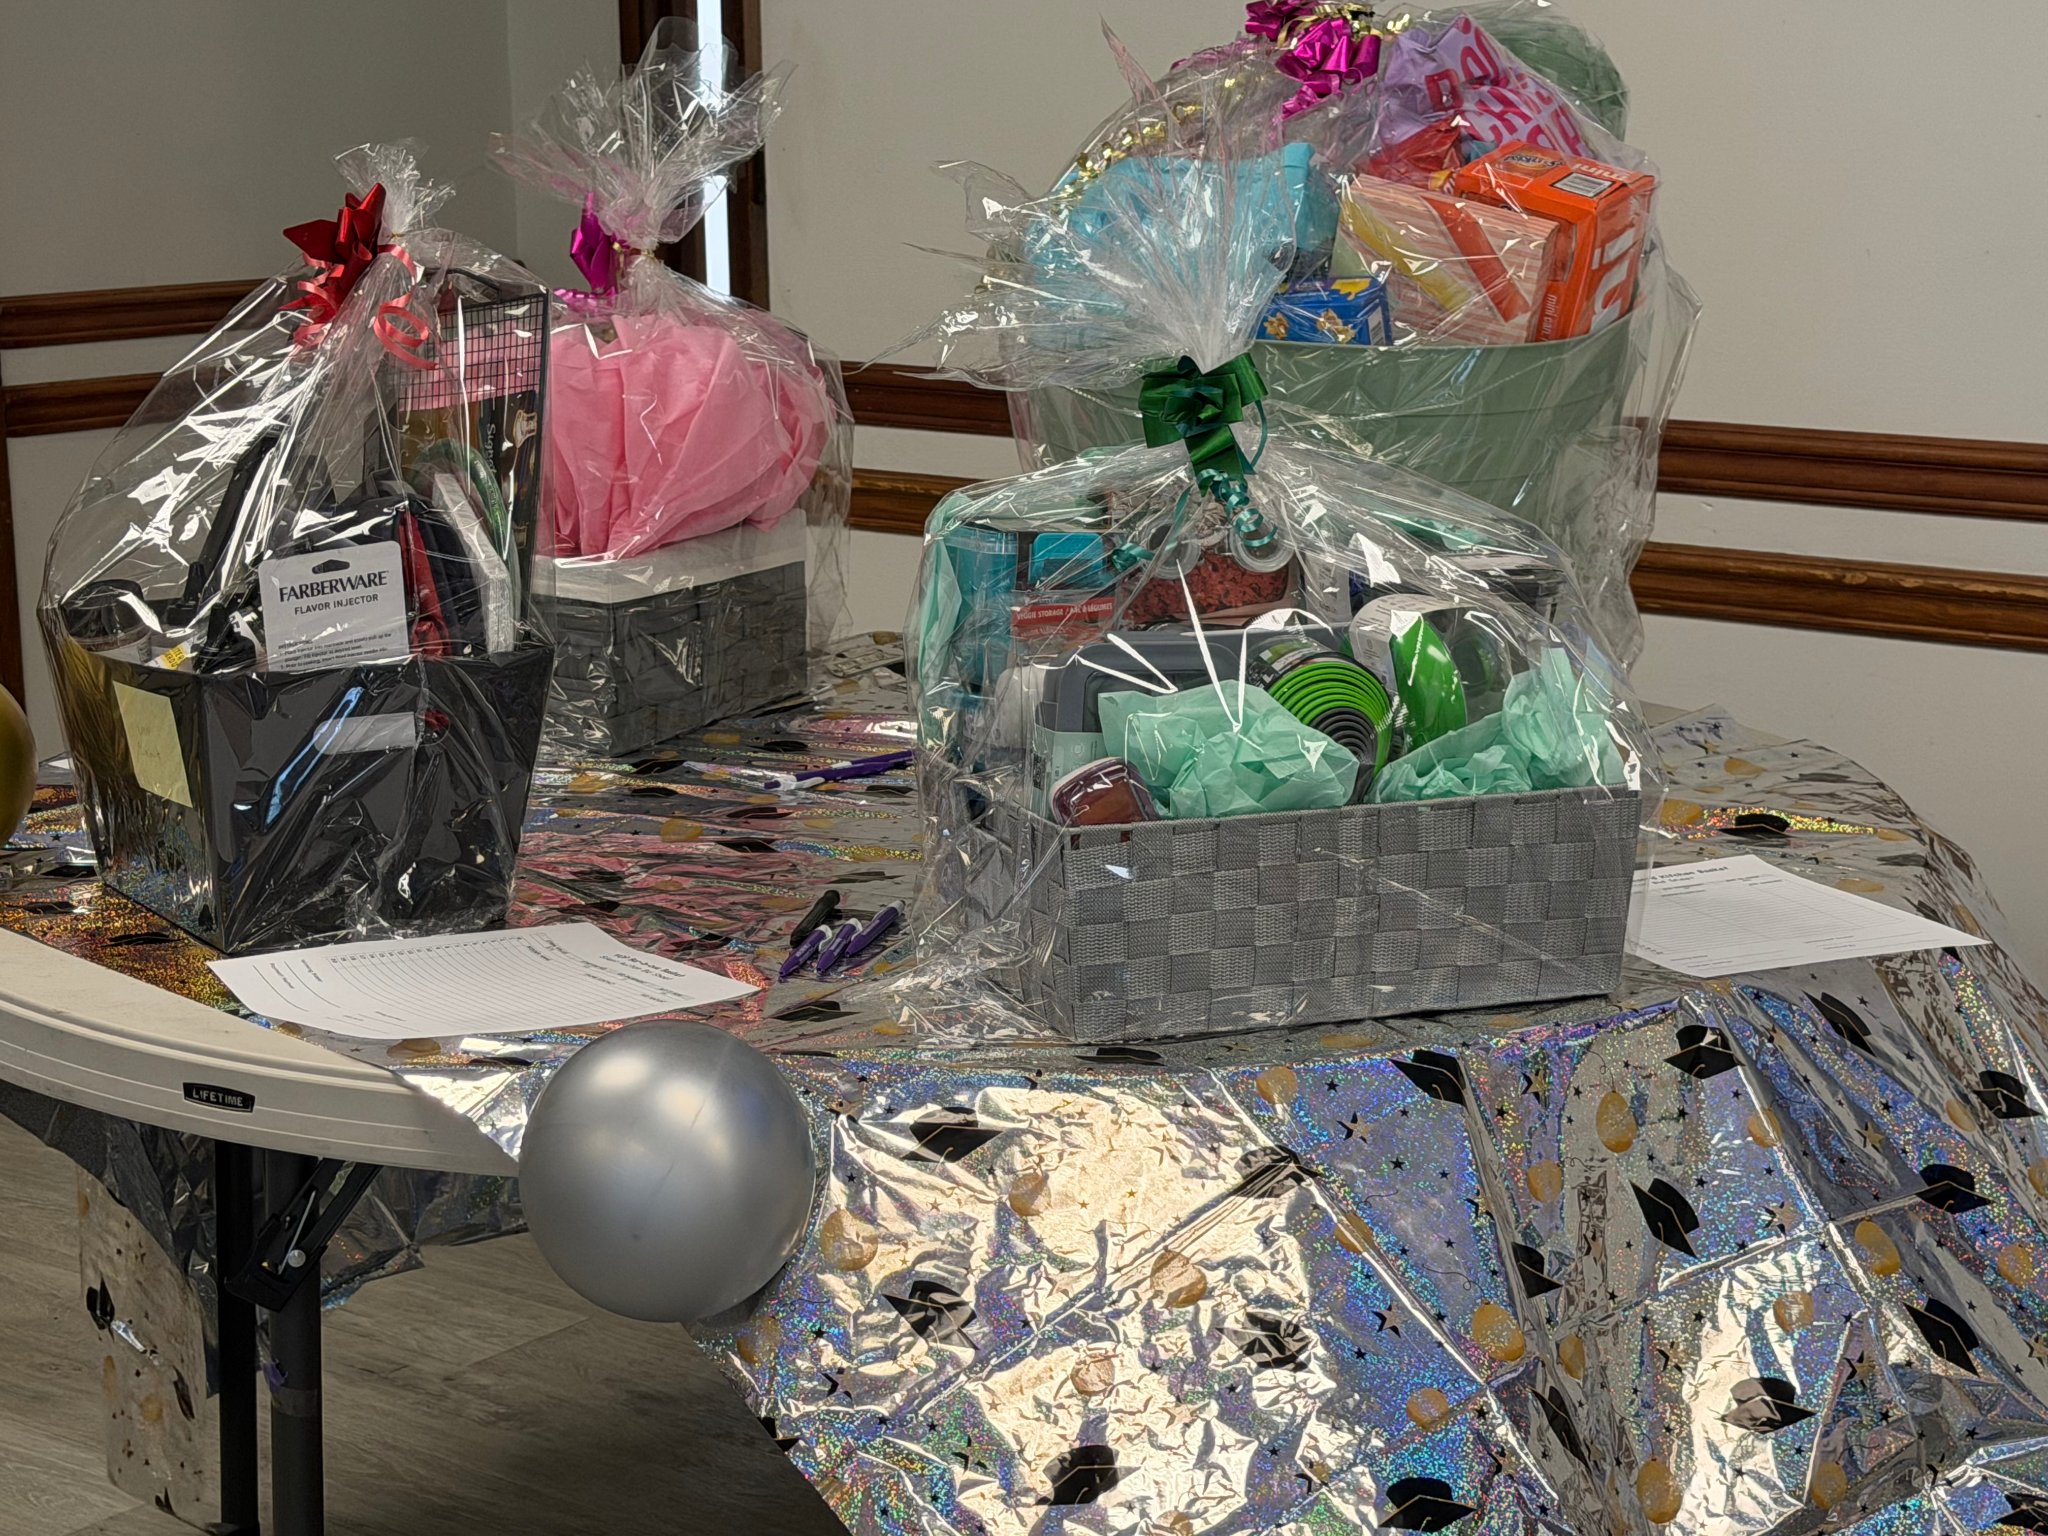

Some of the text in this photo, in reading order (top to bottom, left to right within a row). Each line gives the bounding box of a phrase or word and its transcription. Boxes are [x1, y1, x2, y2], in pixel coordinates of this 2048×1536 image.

[279, 571, 388, 602] FARBERWARE
[294, 594, 379, 615] FLAVOR INJECTOR
[1016, 611, 1036, 620] VEGGIE
[1038, 609, 1064, 618] STORAGE
[192, 1087, 243, 1107] LIFETIME
